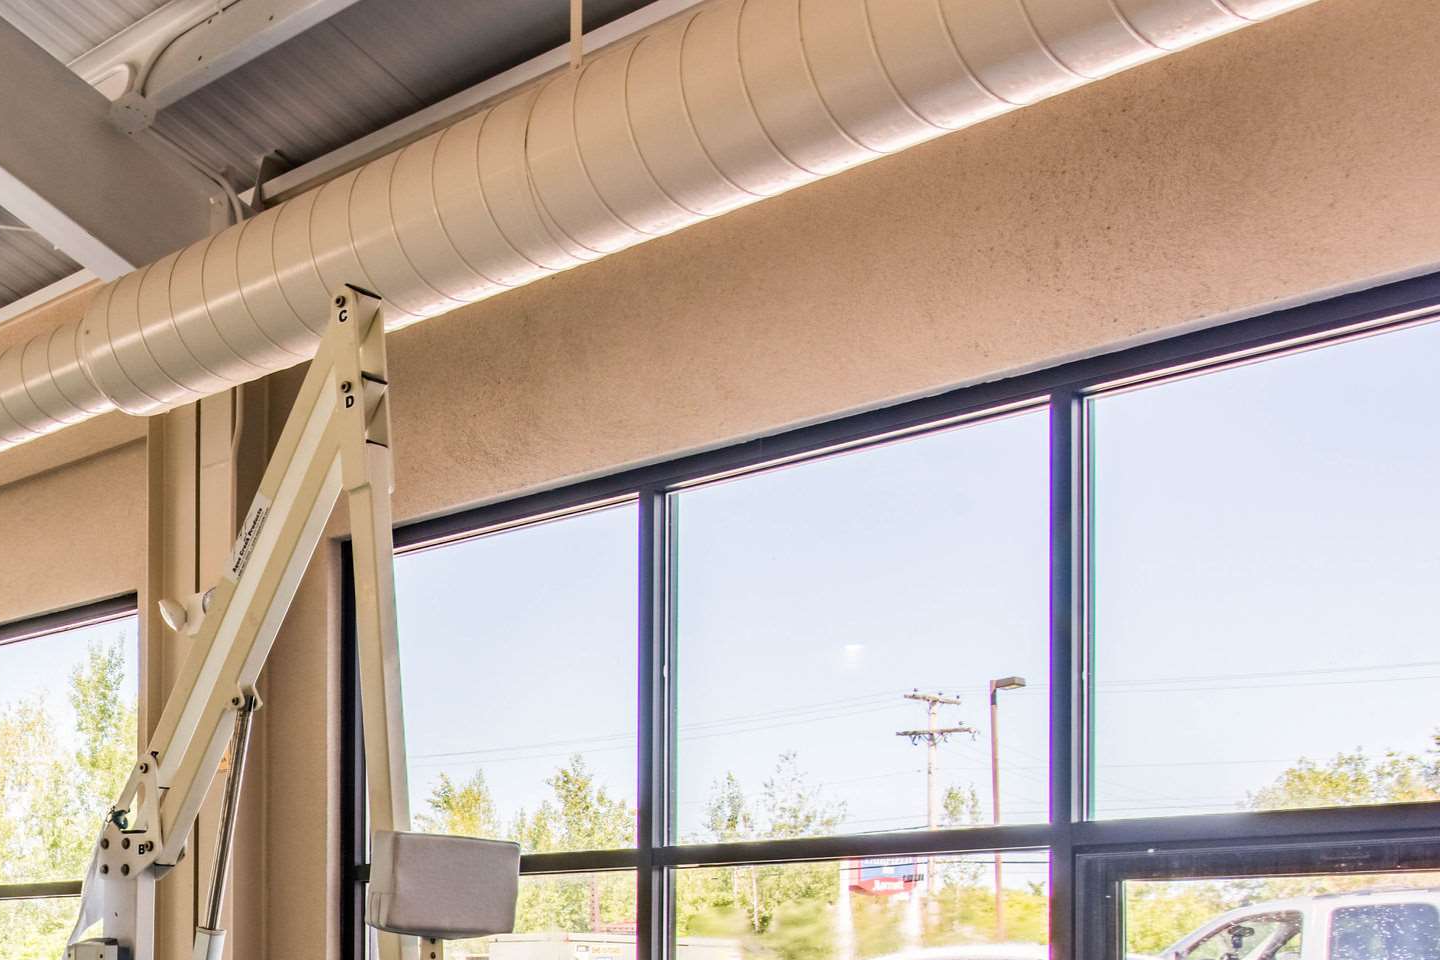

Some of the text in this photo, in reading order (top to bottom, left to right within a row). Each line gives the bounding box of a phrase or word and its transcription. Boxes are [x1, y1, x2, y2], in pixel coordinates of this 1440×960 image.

[338, 309, 348, 323] C
[345, 395, 354, 409] D
[138, 843, 145, 855] B
